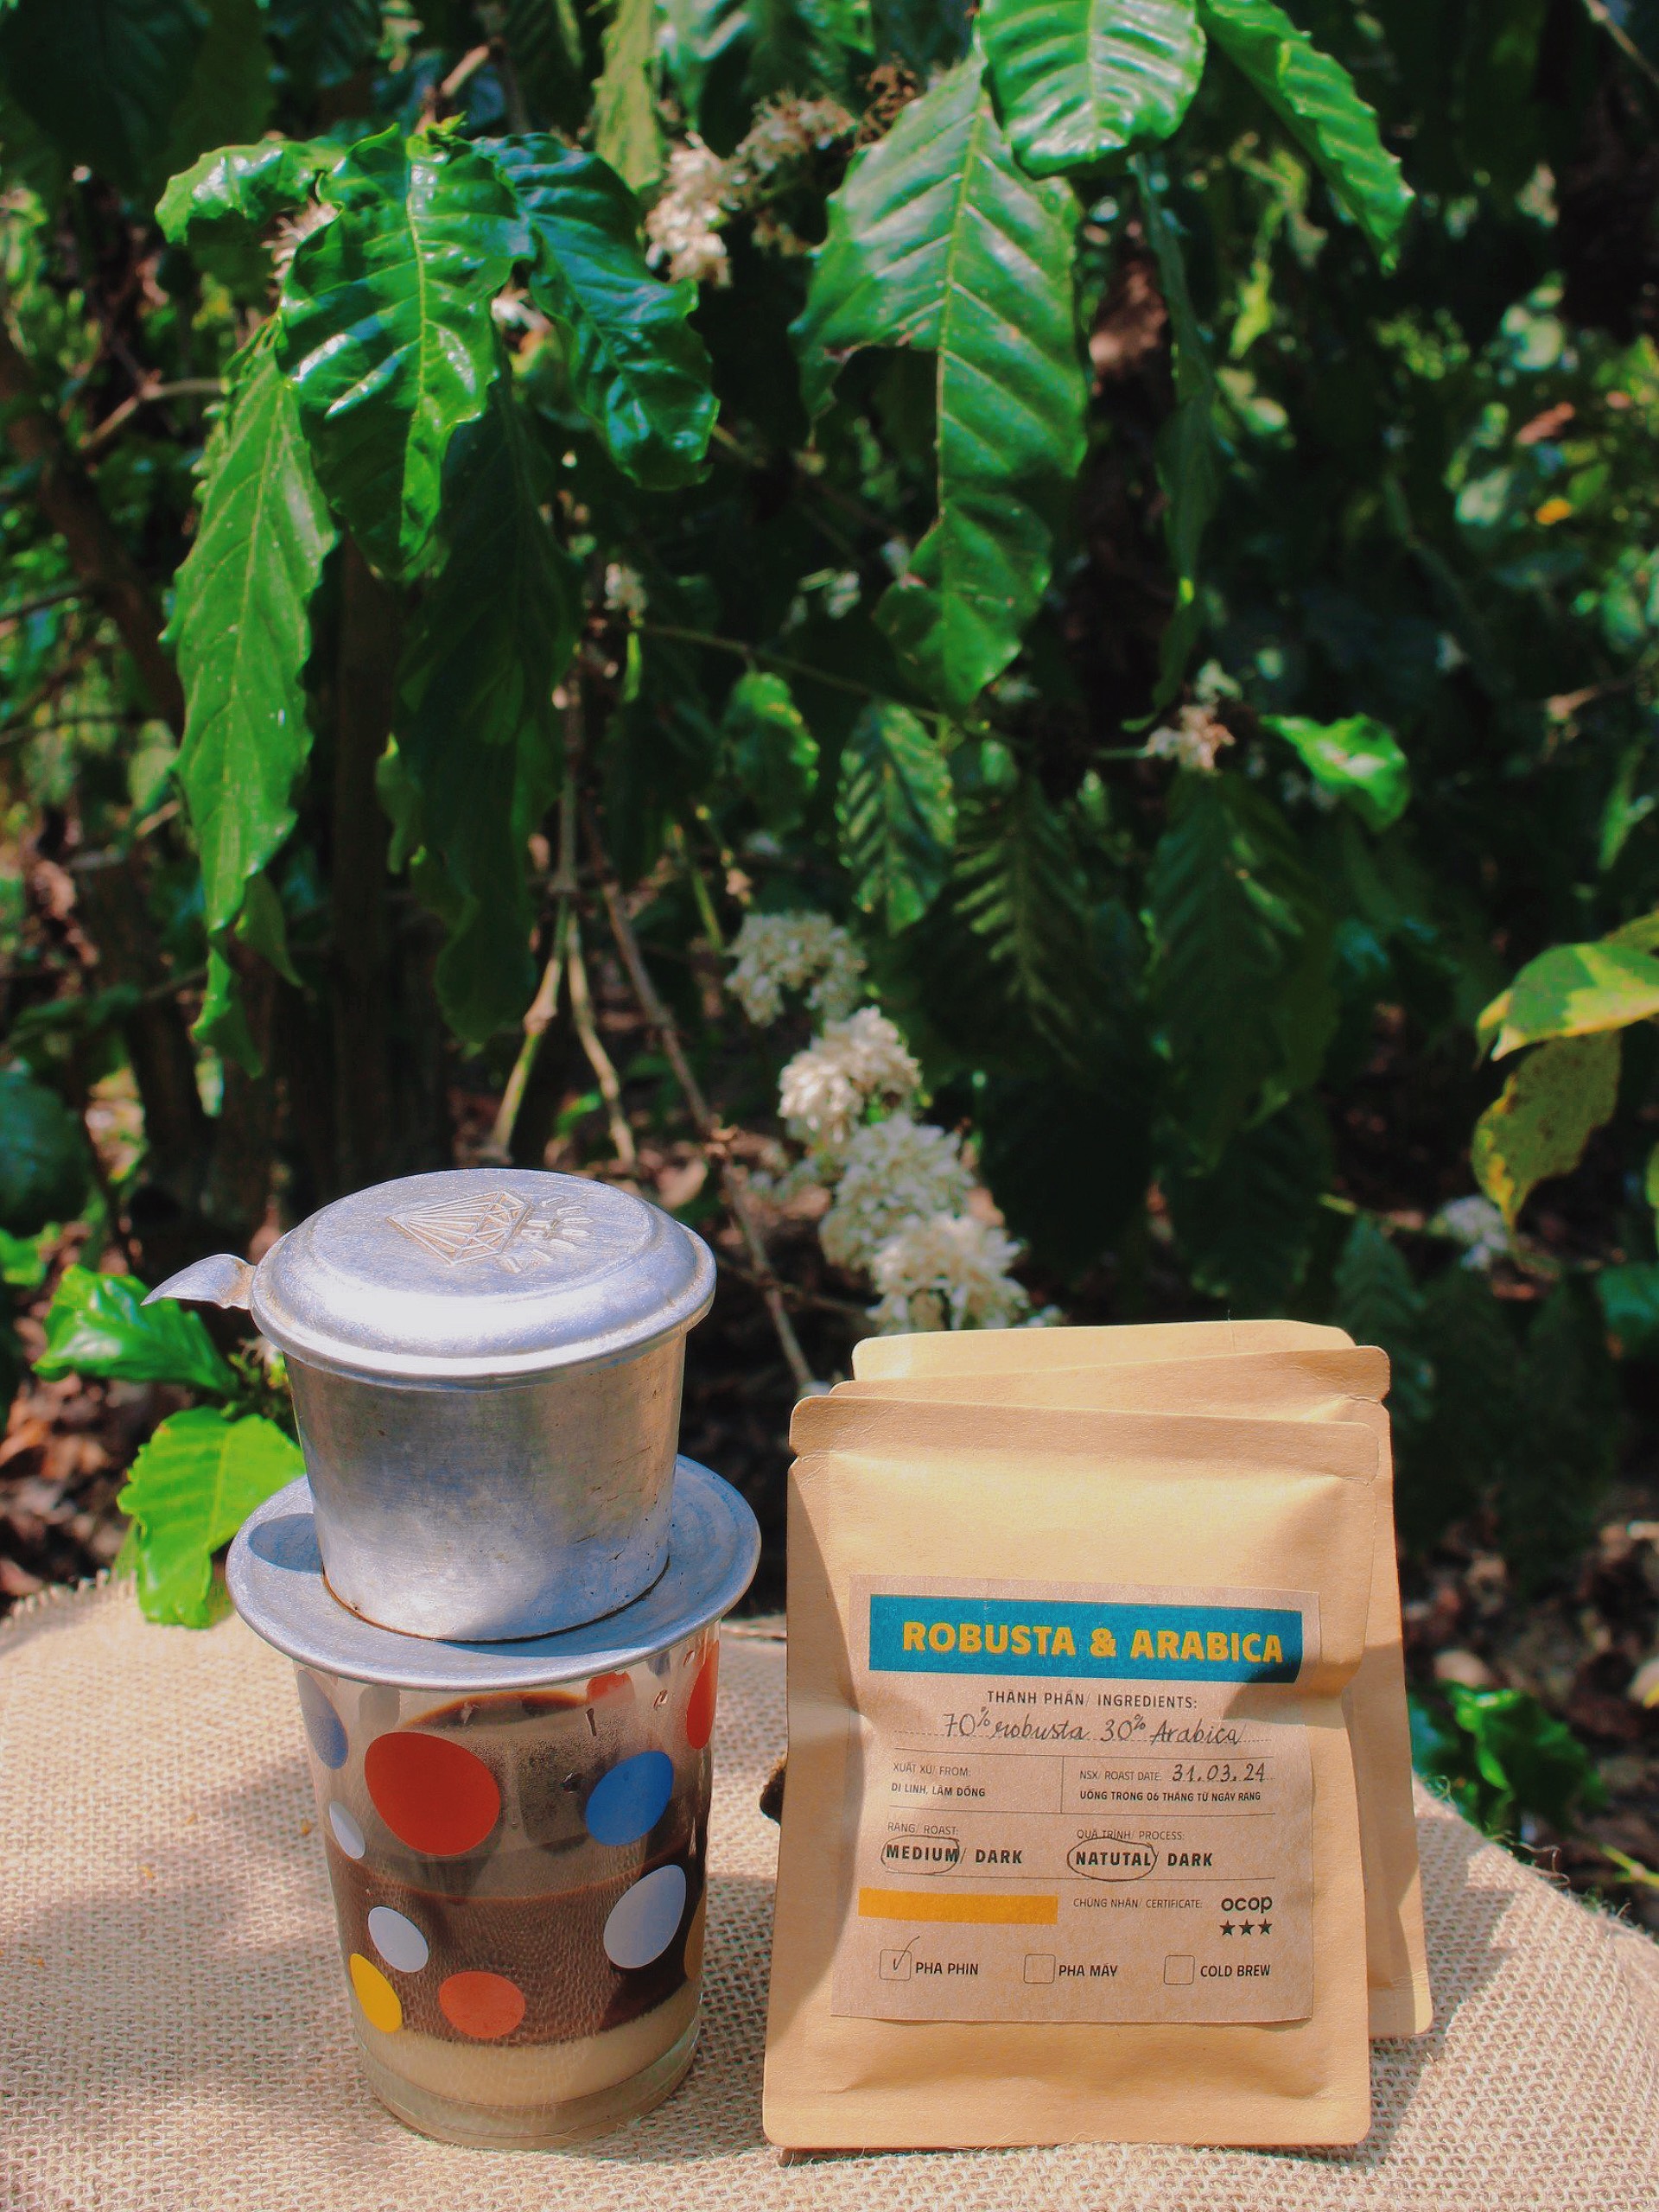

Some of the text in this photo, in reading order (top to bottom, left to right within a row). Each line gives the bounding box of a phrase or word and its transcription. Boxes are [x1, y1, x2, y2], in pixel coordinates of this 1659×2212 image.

[902, 1621, 1283, 1663] ROBUSTA & ARABICA
[987, 1689, 1037, 1705] THÀNH
[1097, 1694, 1198, 1709] INGREDIENTS:
[942, 1707, 1247, 1746] 70% robusta 30% Arabica
[939, 1765, 971, 1777] FROM:
[1104, 1770, 1135, 1780] ROAST
[1172, 1762, 1265, 1783] 31.03.24
[891, 1782, 901, 1792] DI
[904, 1783, 928, 1795] LINH,
[1110, 1791, 1143, 1801] TRONG
[1147, 1792, 1159, 1801] 06
[924, 1824, 959, 1835] ROAST:
[1139, 1830, 1185, 1840] PROCESS:
[976, 1848, 1023, 1864] DARK
[1167, 1852, 1213, 1866] DARK
[1146, 1899, 1203, 1909] CERTIFICATE:
[1220, 1895, 1273, 1914] ocop
[915, 1961, 979, 1975] PHA PHIN
[1058, 1964, 1085, 1977] PHA
[1200, 1964, 1271, 1978] COLD BREW
